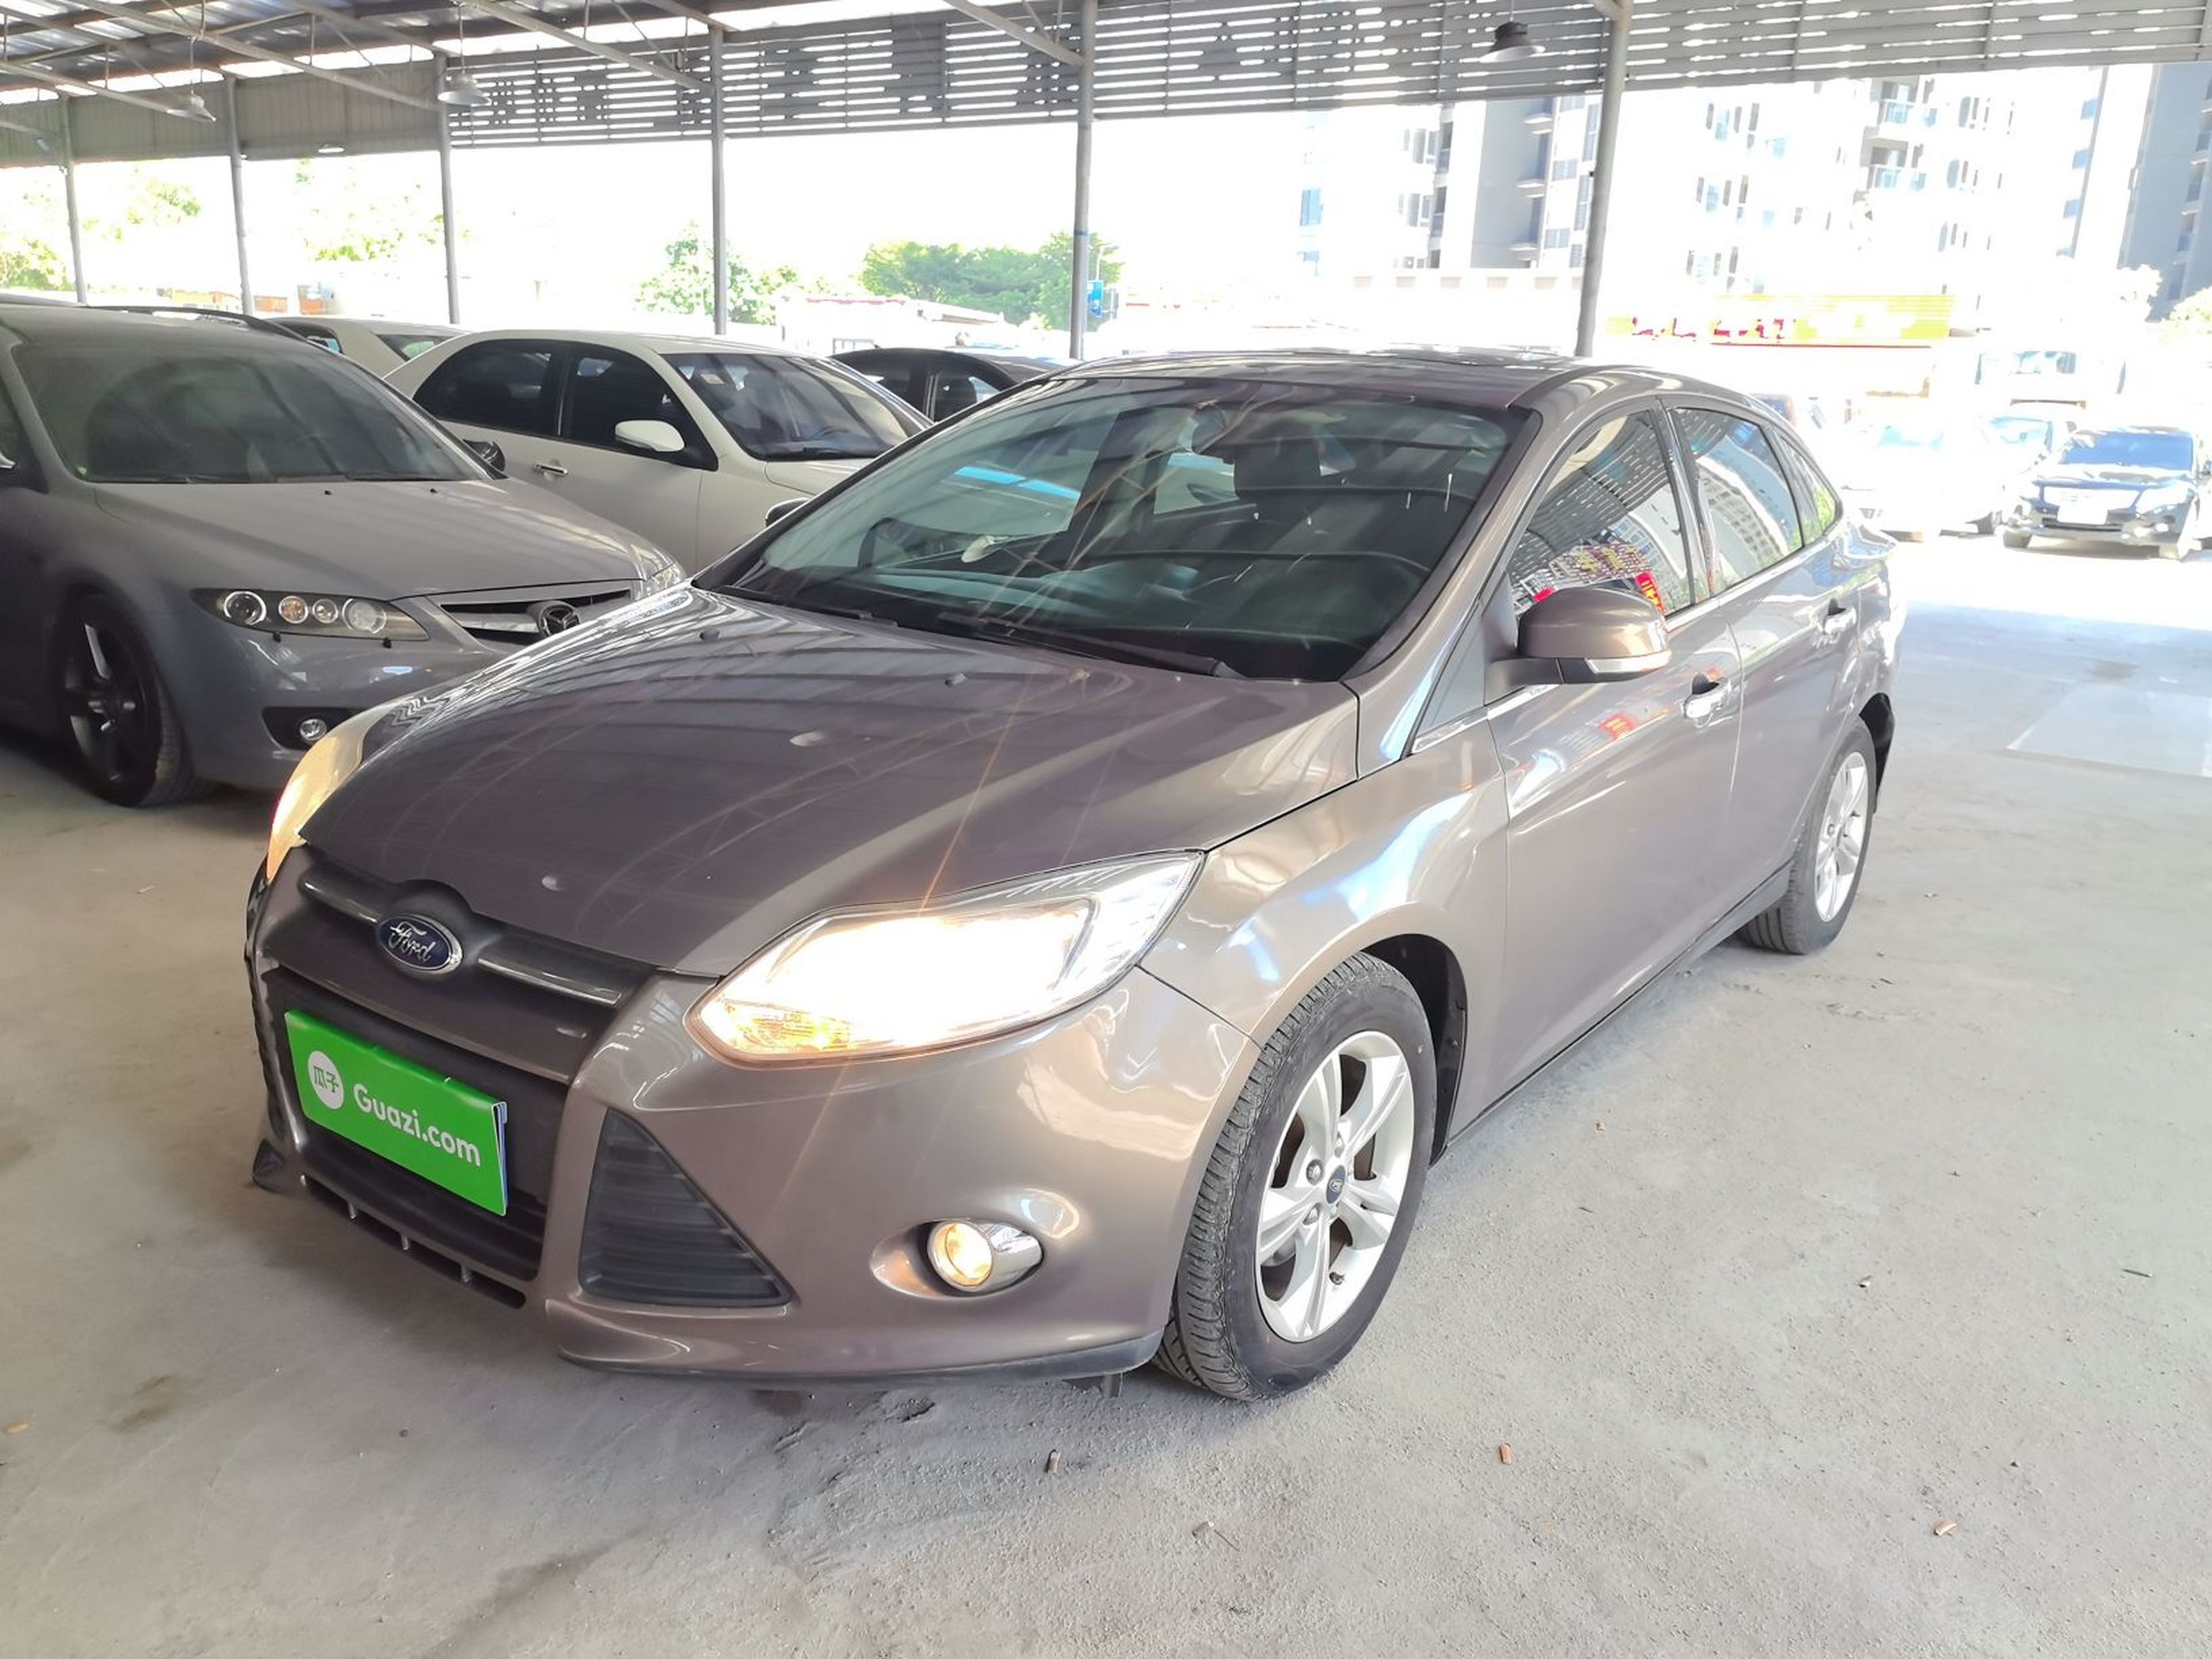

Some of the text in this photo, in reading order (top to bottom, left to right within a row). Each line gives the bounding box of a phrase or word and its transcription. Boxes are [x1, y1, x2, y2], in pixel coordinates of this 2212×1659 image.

[389, 922, 436, 963] Ford
[313, 1065, 339, 1094] 瓜子
[353, 1084, 481, 1167] Guazi.com
